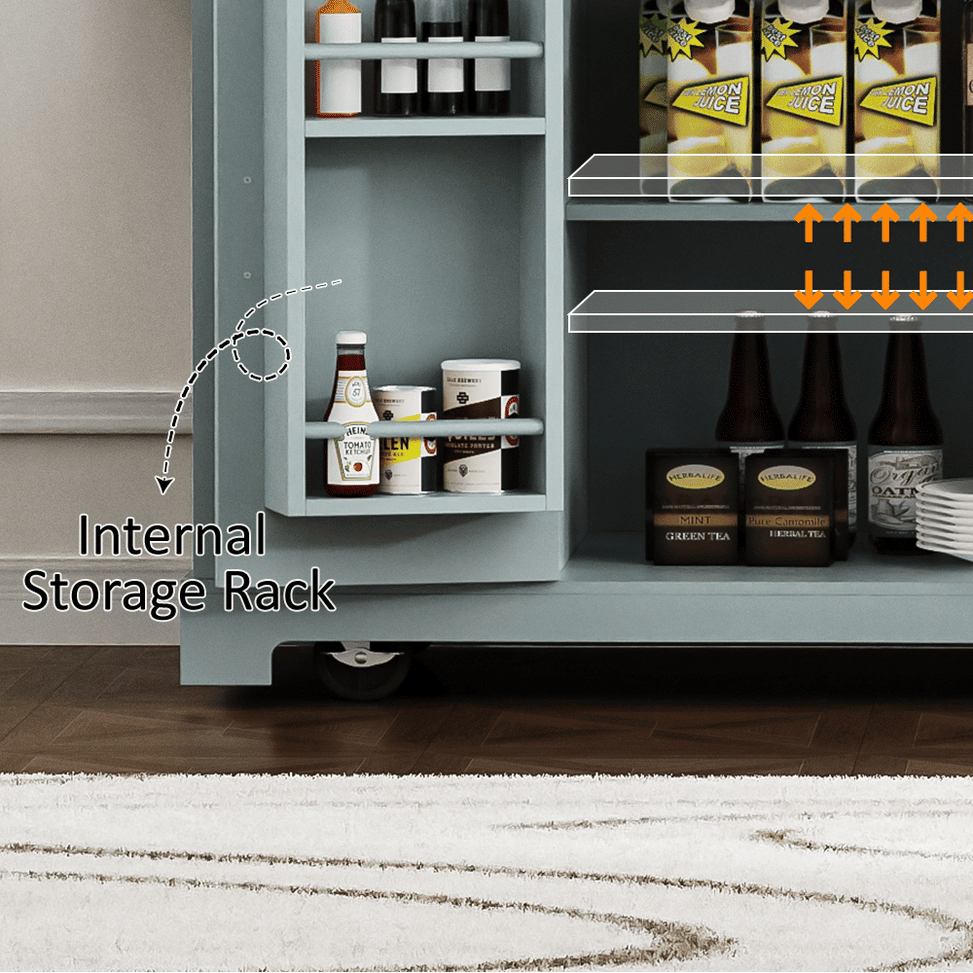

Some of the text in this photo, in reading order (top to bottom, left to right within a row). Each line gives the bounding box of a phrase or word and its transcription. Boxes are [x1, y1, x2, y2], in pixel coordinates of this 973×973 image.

[696, 82, 742, 96] LEMON
[790, 82, 836, 96] LEMON
[883, 82, 929, 96] LEMON
[693, 96, 741, 114] JUICE
[787, 96, 835, 114] JUICE
[880, 96, 928, 114] JUICE
[343, 441, 372, 449] TOMATO
[668, 472, 721, 482] HERBALIFE
[759, 472, 815, 483] HERBALIFE
[680, 516, 711, 524] MINT
[748, 516, 826, 526] Pure Camomile
[665, 532, 731, 541] GREEN TEA
[769, 530, 827, 538] HERBAL TEA
